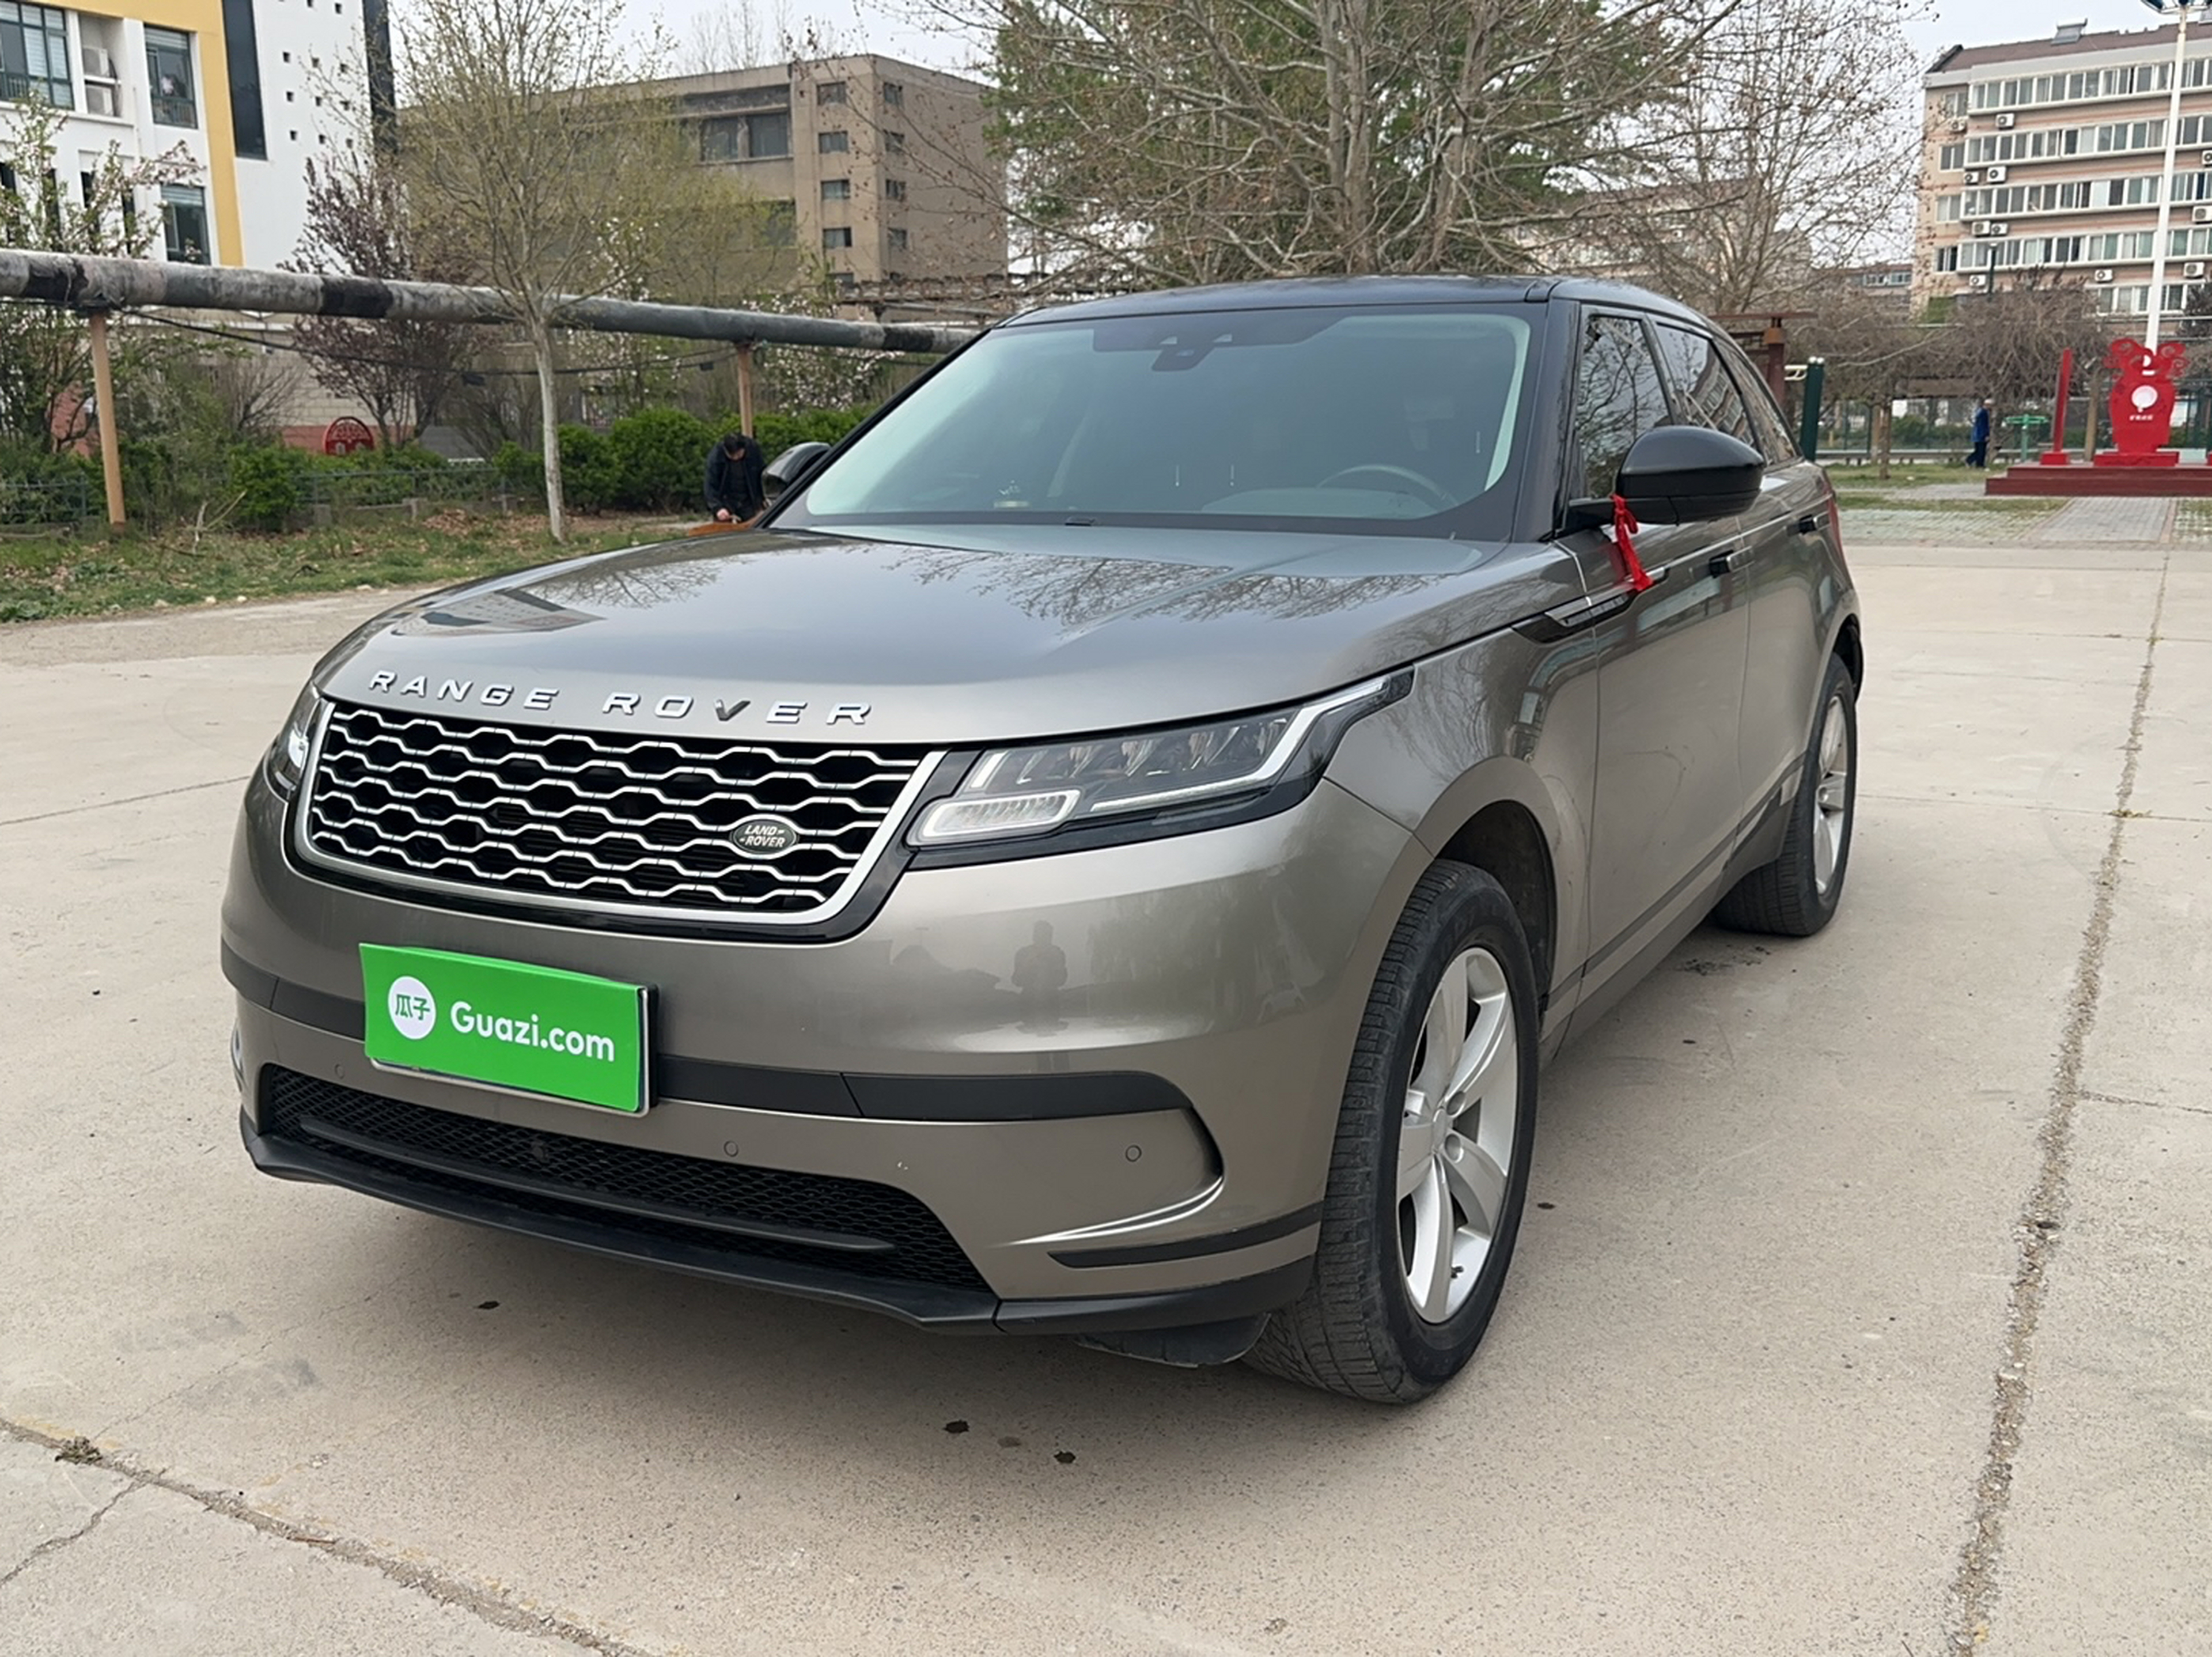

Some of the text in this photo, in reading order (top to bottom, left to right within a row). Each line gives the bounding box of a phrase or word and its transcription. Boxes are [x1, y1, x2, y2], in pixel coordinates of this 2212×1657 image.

[369, 670, 871, 724] RANGE ROVER
[395, 994, 430, 1020] 瓜子
[450, 1001, 614, 1062] Guazi.com
